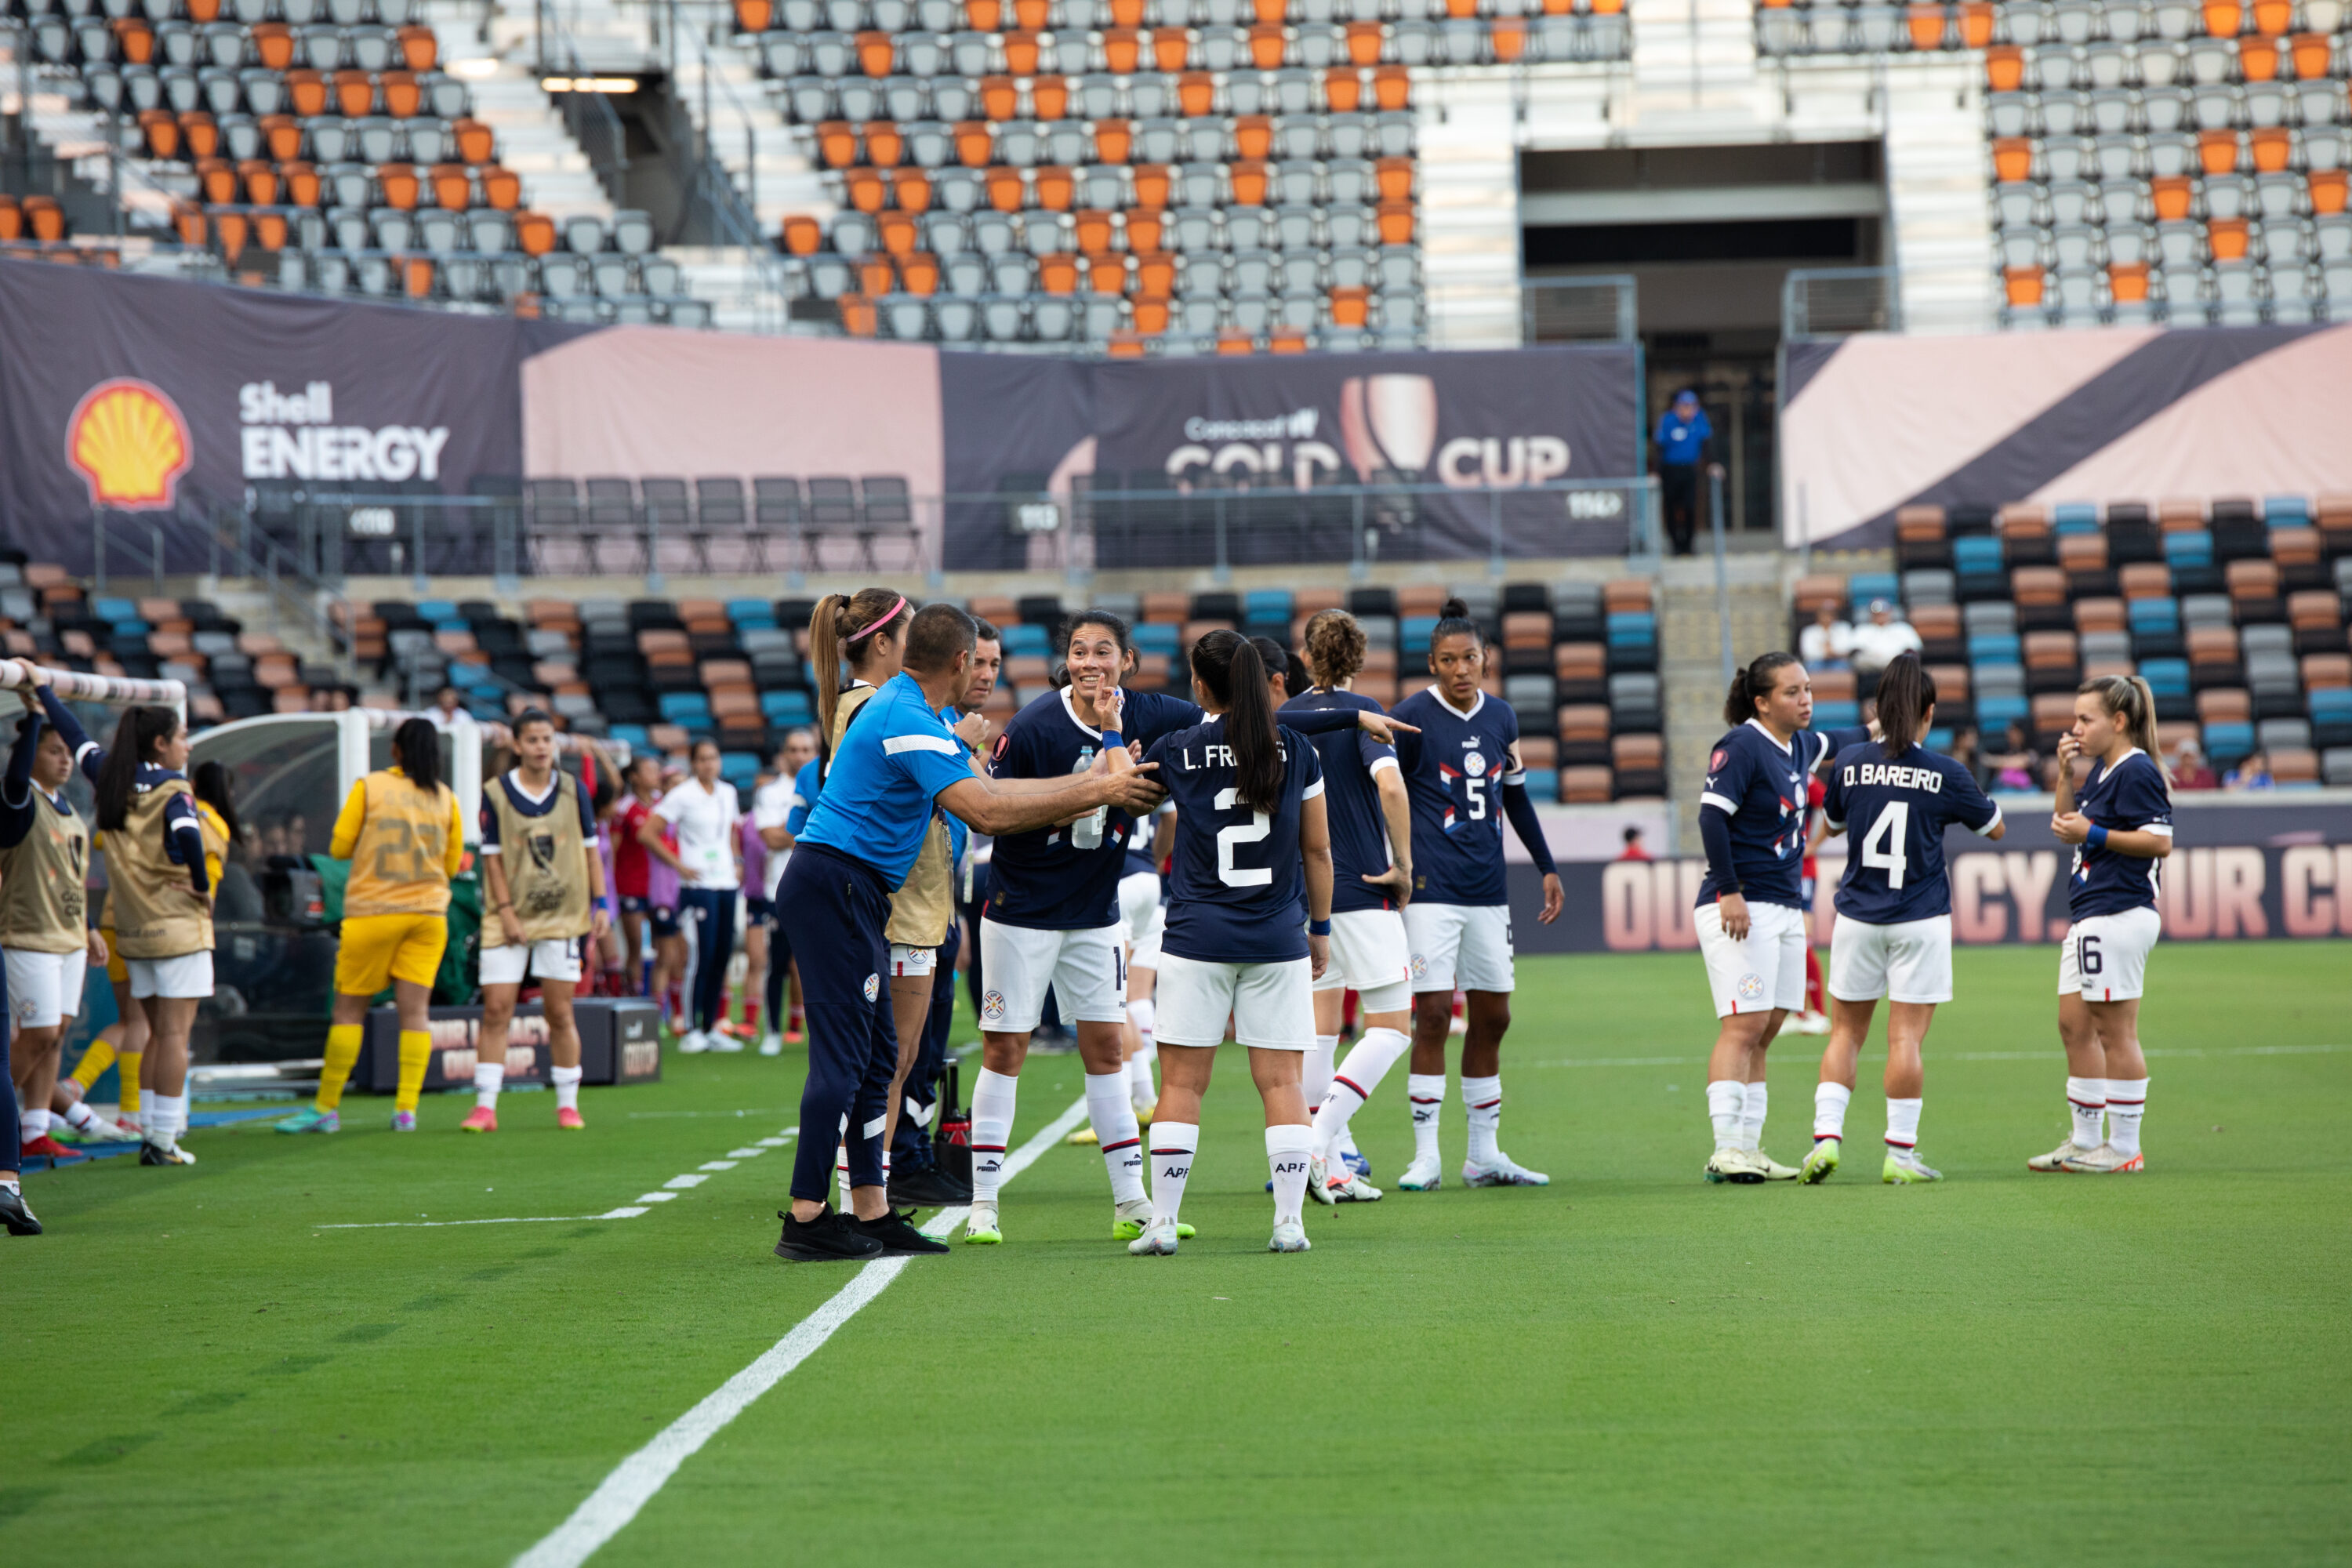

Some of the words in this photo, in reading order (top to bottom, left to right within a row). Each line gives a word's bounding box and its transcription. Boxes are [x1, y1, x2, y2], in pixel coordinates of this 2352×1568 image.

[239, 379, 332, 424] Shell
[241, 424, 450, 482] ENERGY
[1437, 436, 1570, 489] CUP
[1183, 748, 1202, 771] L.
[1844, 765, 1858, 787] D.
[1861, 764, 1943, 794] BAREIRO
[1466, 779, 1486, 820] 5
[1214, 787, 1272, 887] 2
[1862, 800, 1909, 890] 4
[2160, 846, 2270, 940] UR
[2078, 935, 2102, 975] 16
[1323, 1092, 1338, 1103] PF
[1164, 1167, 1189, 1179] APF
[1276, 1163, 1306, 1174] APF
